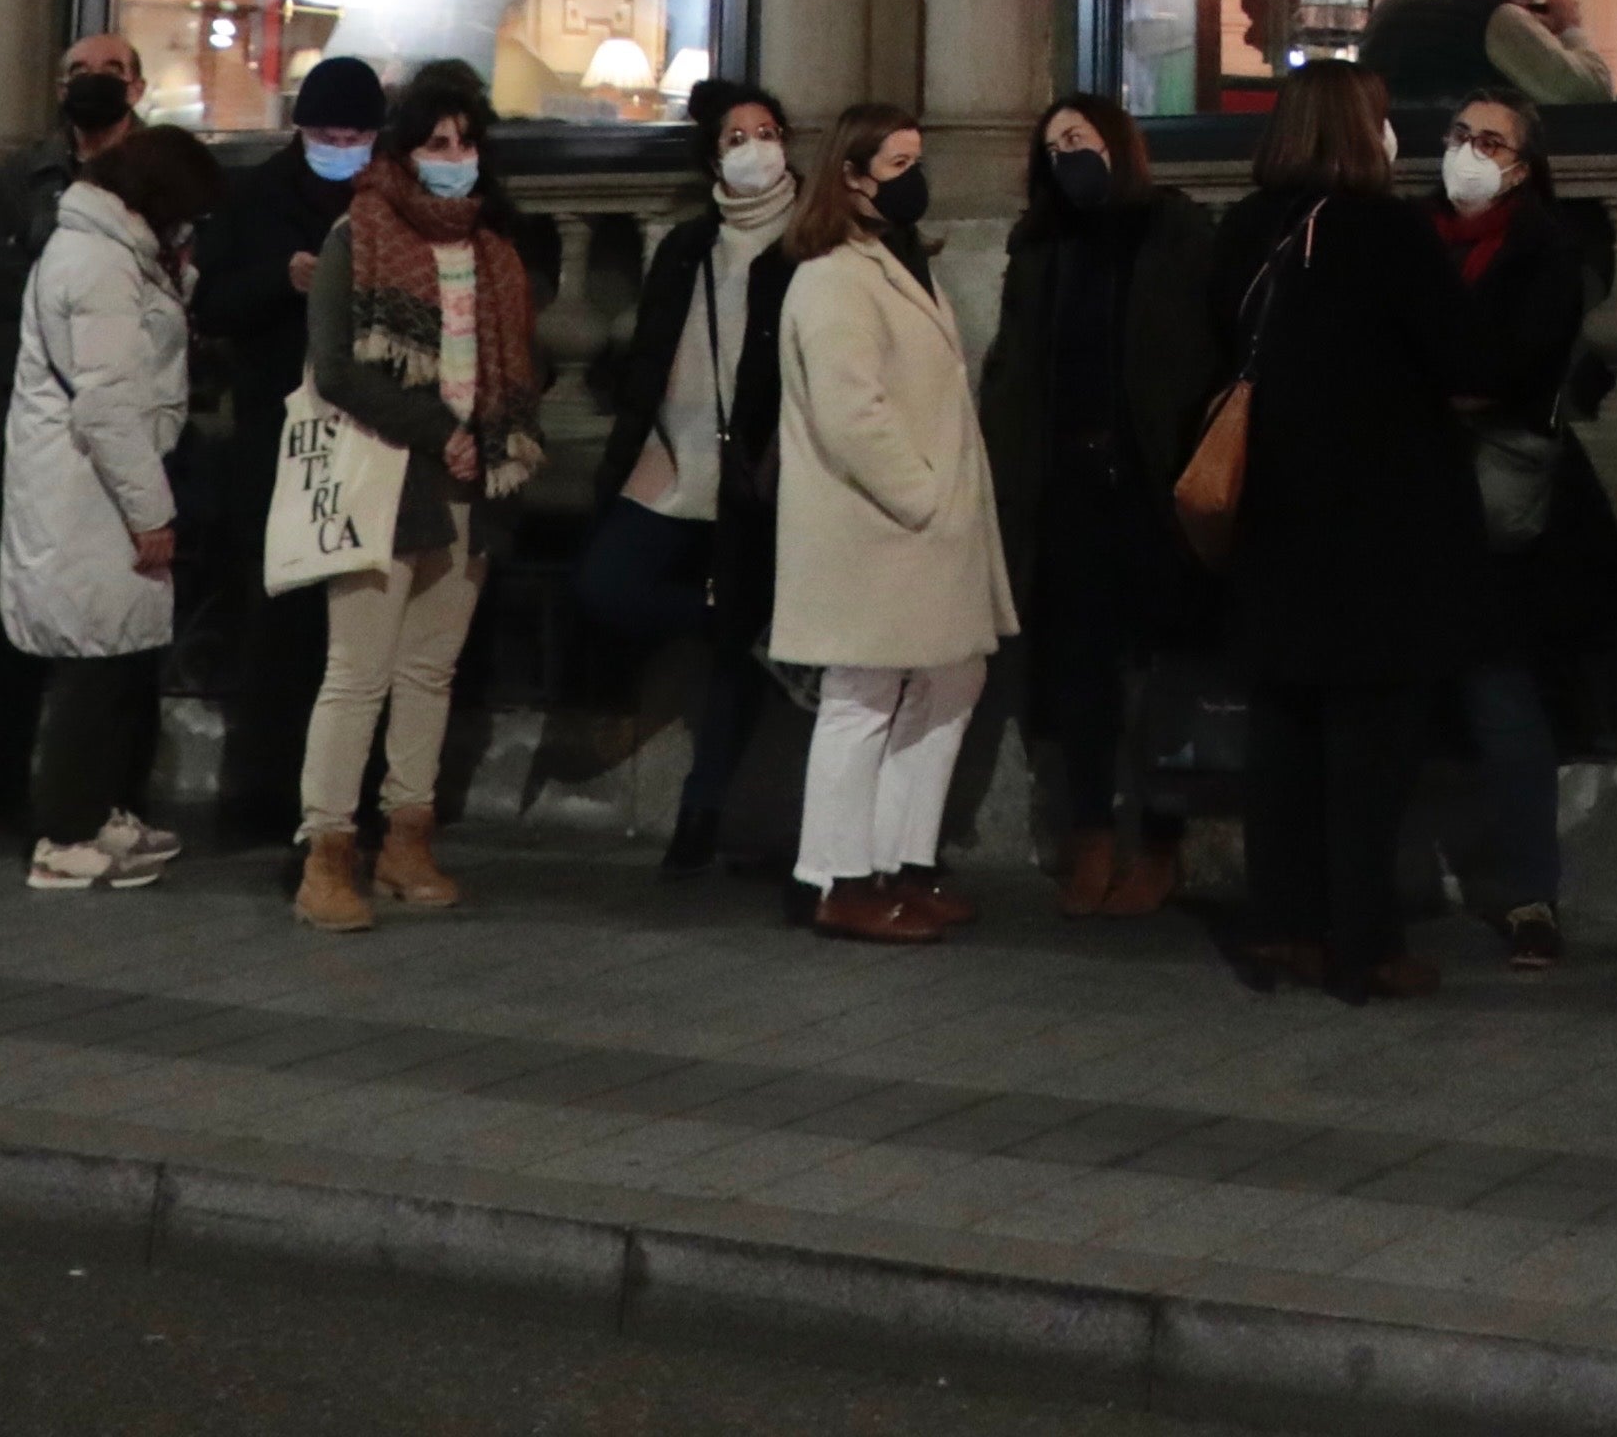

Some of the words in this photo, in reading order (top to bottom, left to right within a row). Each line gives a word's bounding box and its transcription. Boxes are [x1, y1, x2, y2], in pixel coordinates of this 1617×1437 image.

[288, 418, 337, 457] HIS
[311, 482, 341, 523] RI
[319, 515, 362, 554] CA
